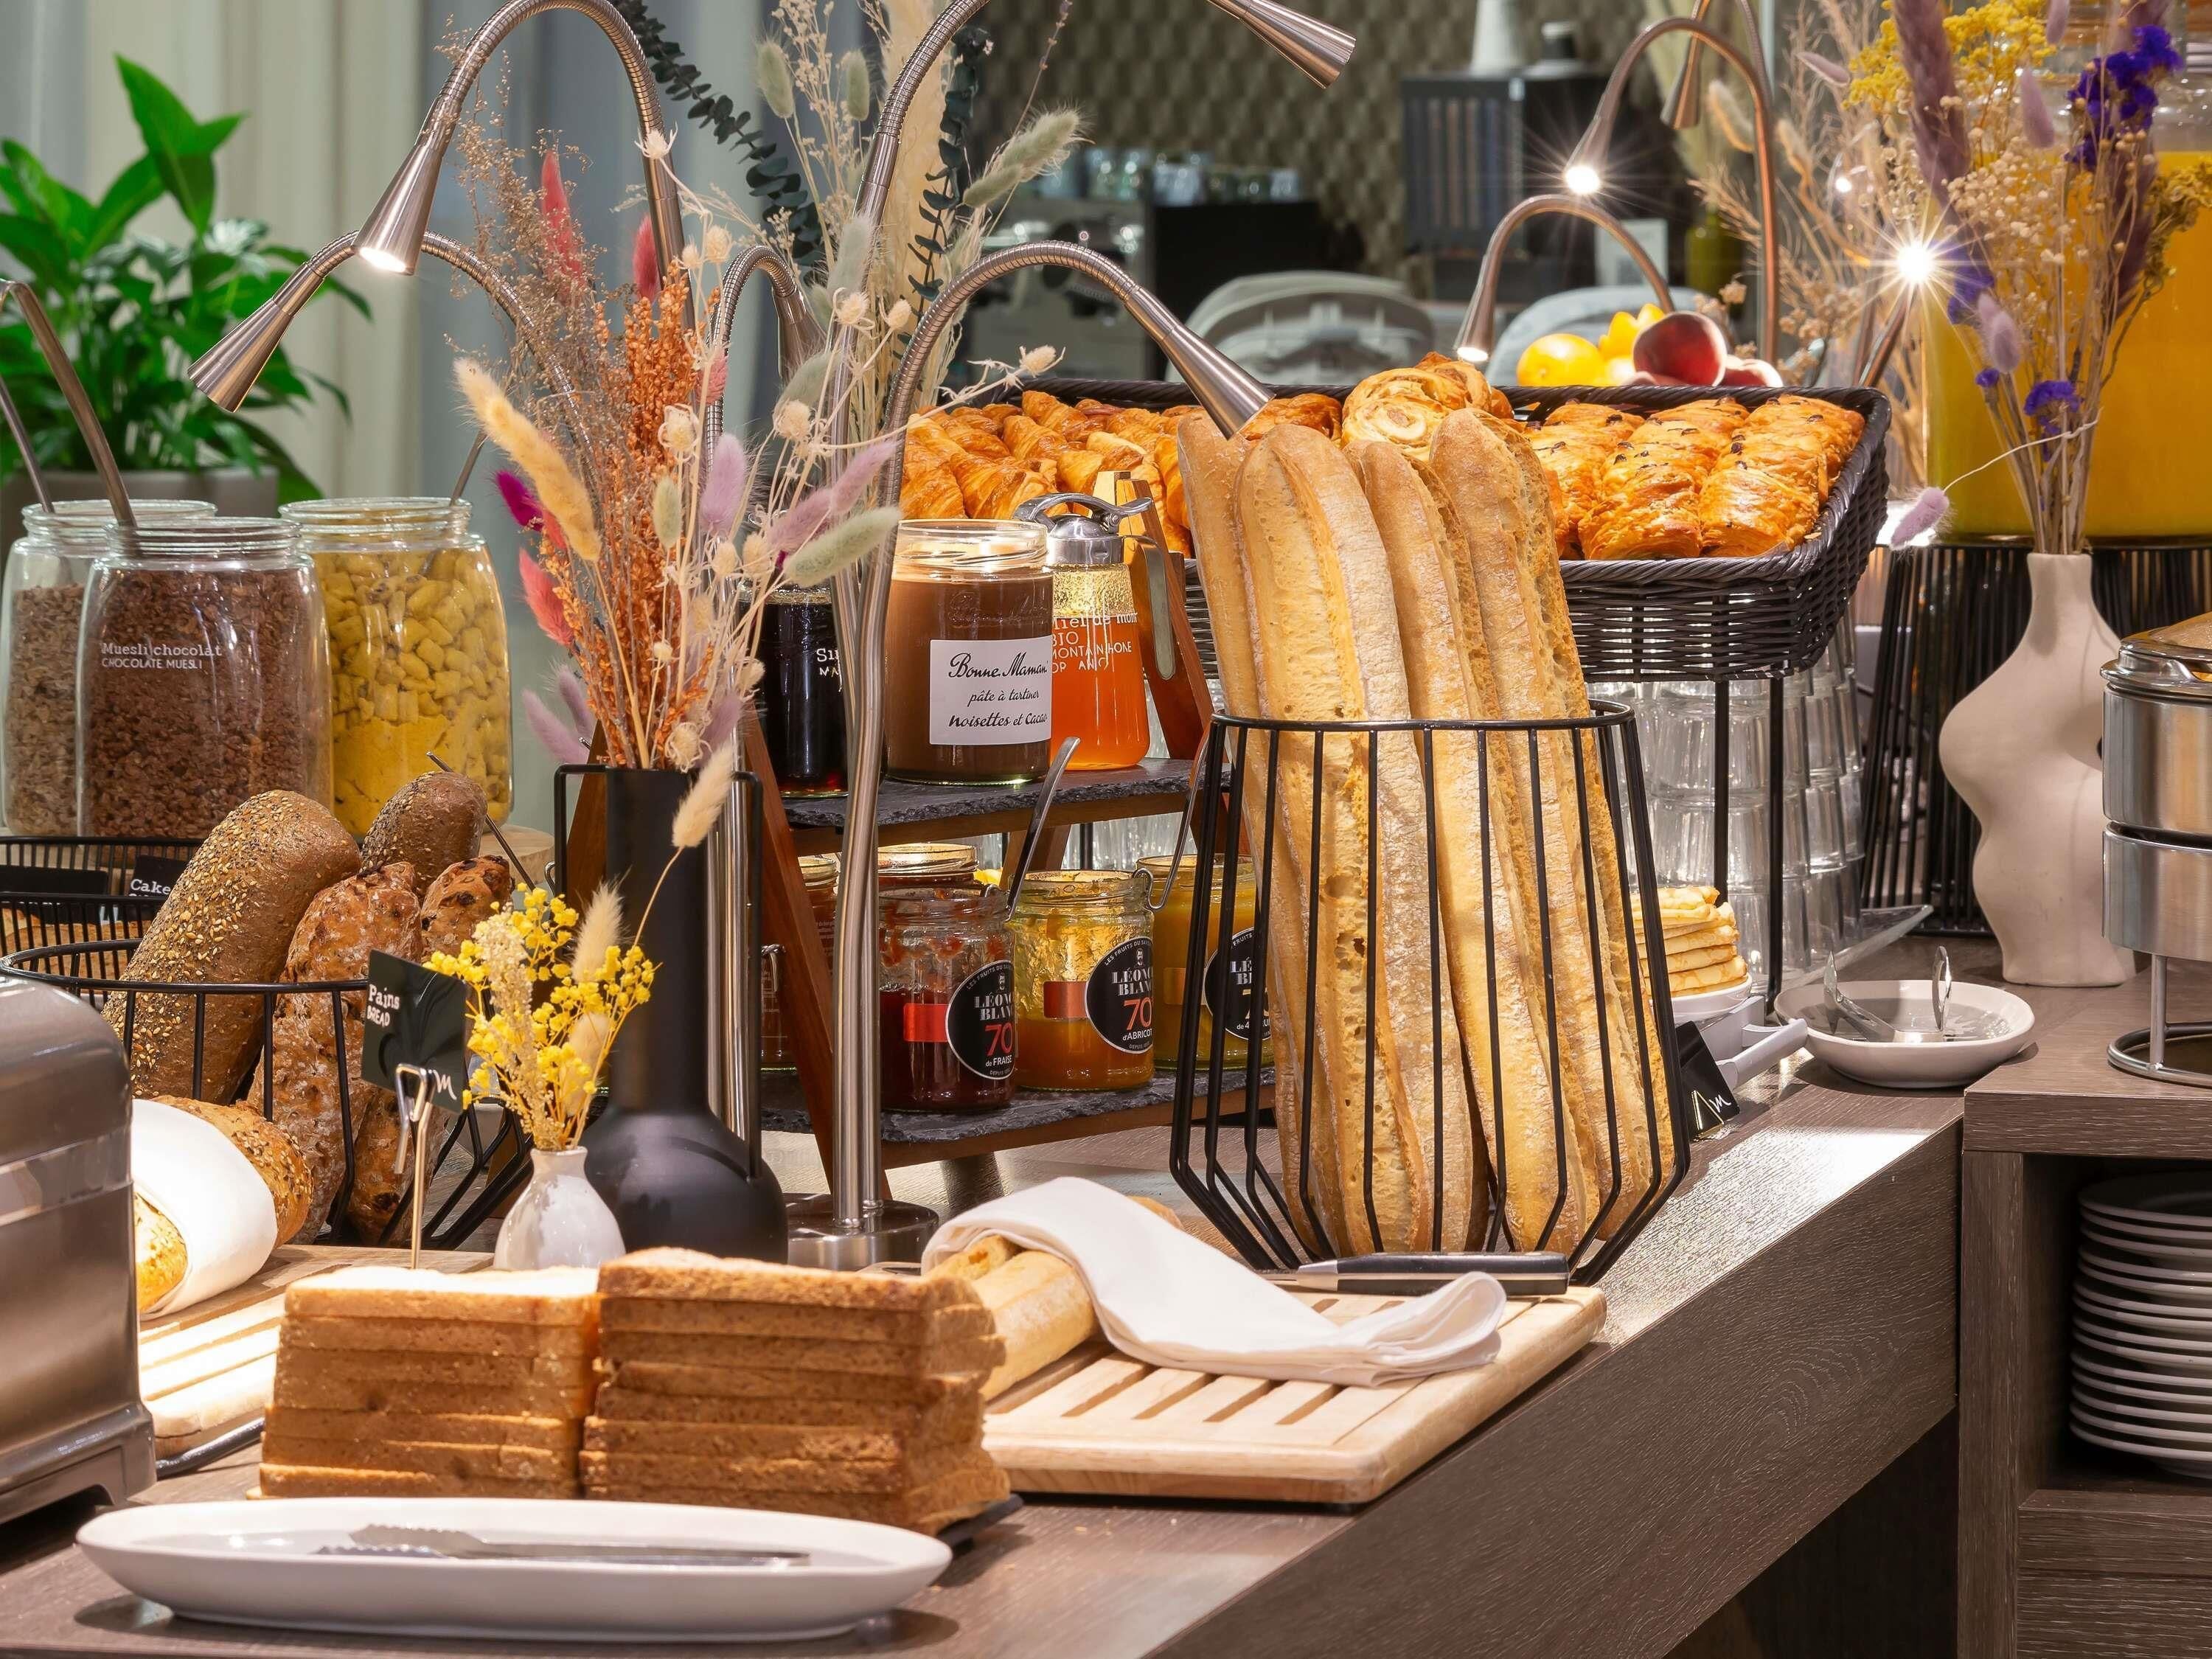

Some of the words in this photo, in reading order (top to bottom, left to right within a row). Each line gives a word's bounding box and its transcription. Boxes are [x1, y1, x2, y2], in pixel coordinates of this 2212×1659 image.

[100, 643, 148, 655] Muesli
[153, 644, 222, 656] chocolat
[102, 658, 163, 668] CHOCOLATE
[166, 658, 202, 669] MUESLI
[948, 653, 1001, 678] Bonne
[1003, 651, 1048, 678] Maman
[967, 689, 995, 707] pâte
[998, 690, 1006, 700] à
[1009, 687, 1040, 701] tartiner
[948, 712, 1011, 727] noisettes
[1013, 712, 1023, 726] et
[130, 878, 172, 895] Cake
[1115, 942, 1133, 957] FRUITS
[369, 984, 400, 1010] Pains
[366, 1005, 391, 1027] BREAD
[985, 1022, 1012, 1057] 70
[993, 1054, 1012, 1066] FRAISE
